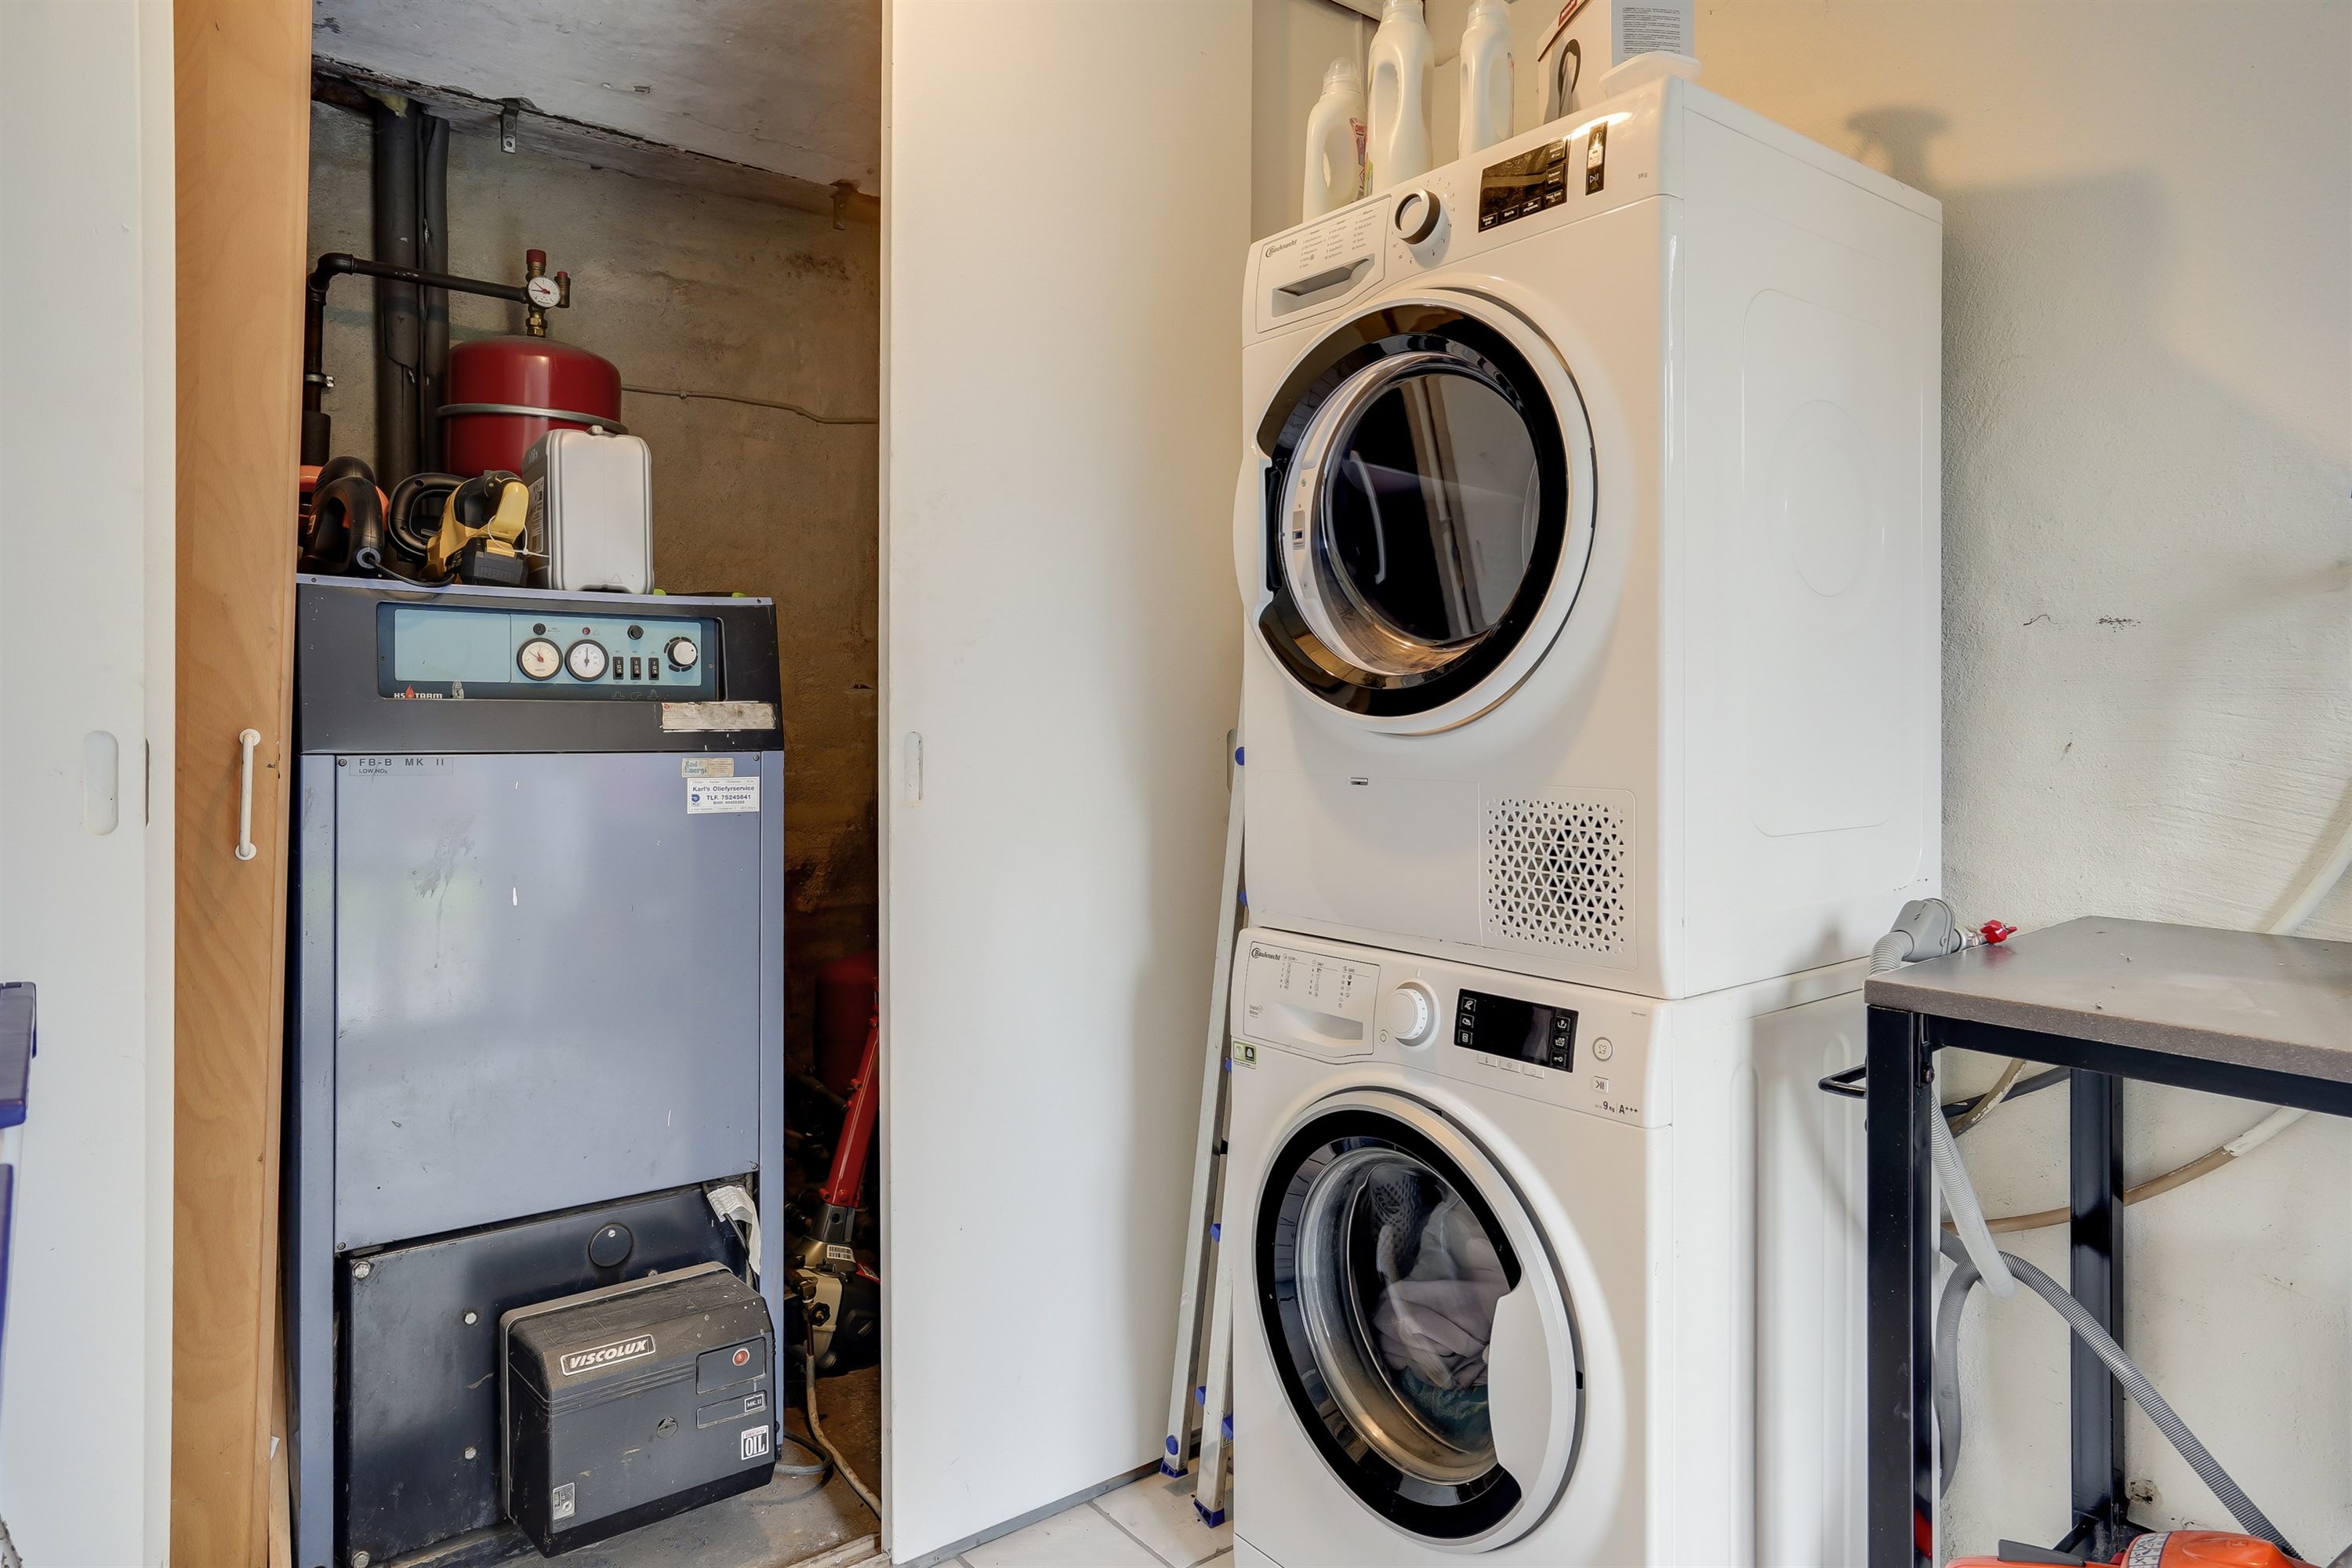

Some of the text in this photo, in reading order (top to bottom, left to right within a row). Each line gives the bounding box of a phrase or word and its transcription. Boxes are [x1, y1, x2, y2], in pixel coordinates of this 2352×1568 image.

[1265, 239, 1298, 258] Bauknecht
[359, 758, 392, 767] FB-B
[405, 758, 424, 767] MK
[1251, 947, 1281, 961] Bauknecht
[1603, 1101, 1609, 1110] 9
[1618, 1104, 1639, 1115] A+++
[569, 1339, 648, 1369] VISCOLUX
[745, 1434, 765, 1457] OIL
